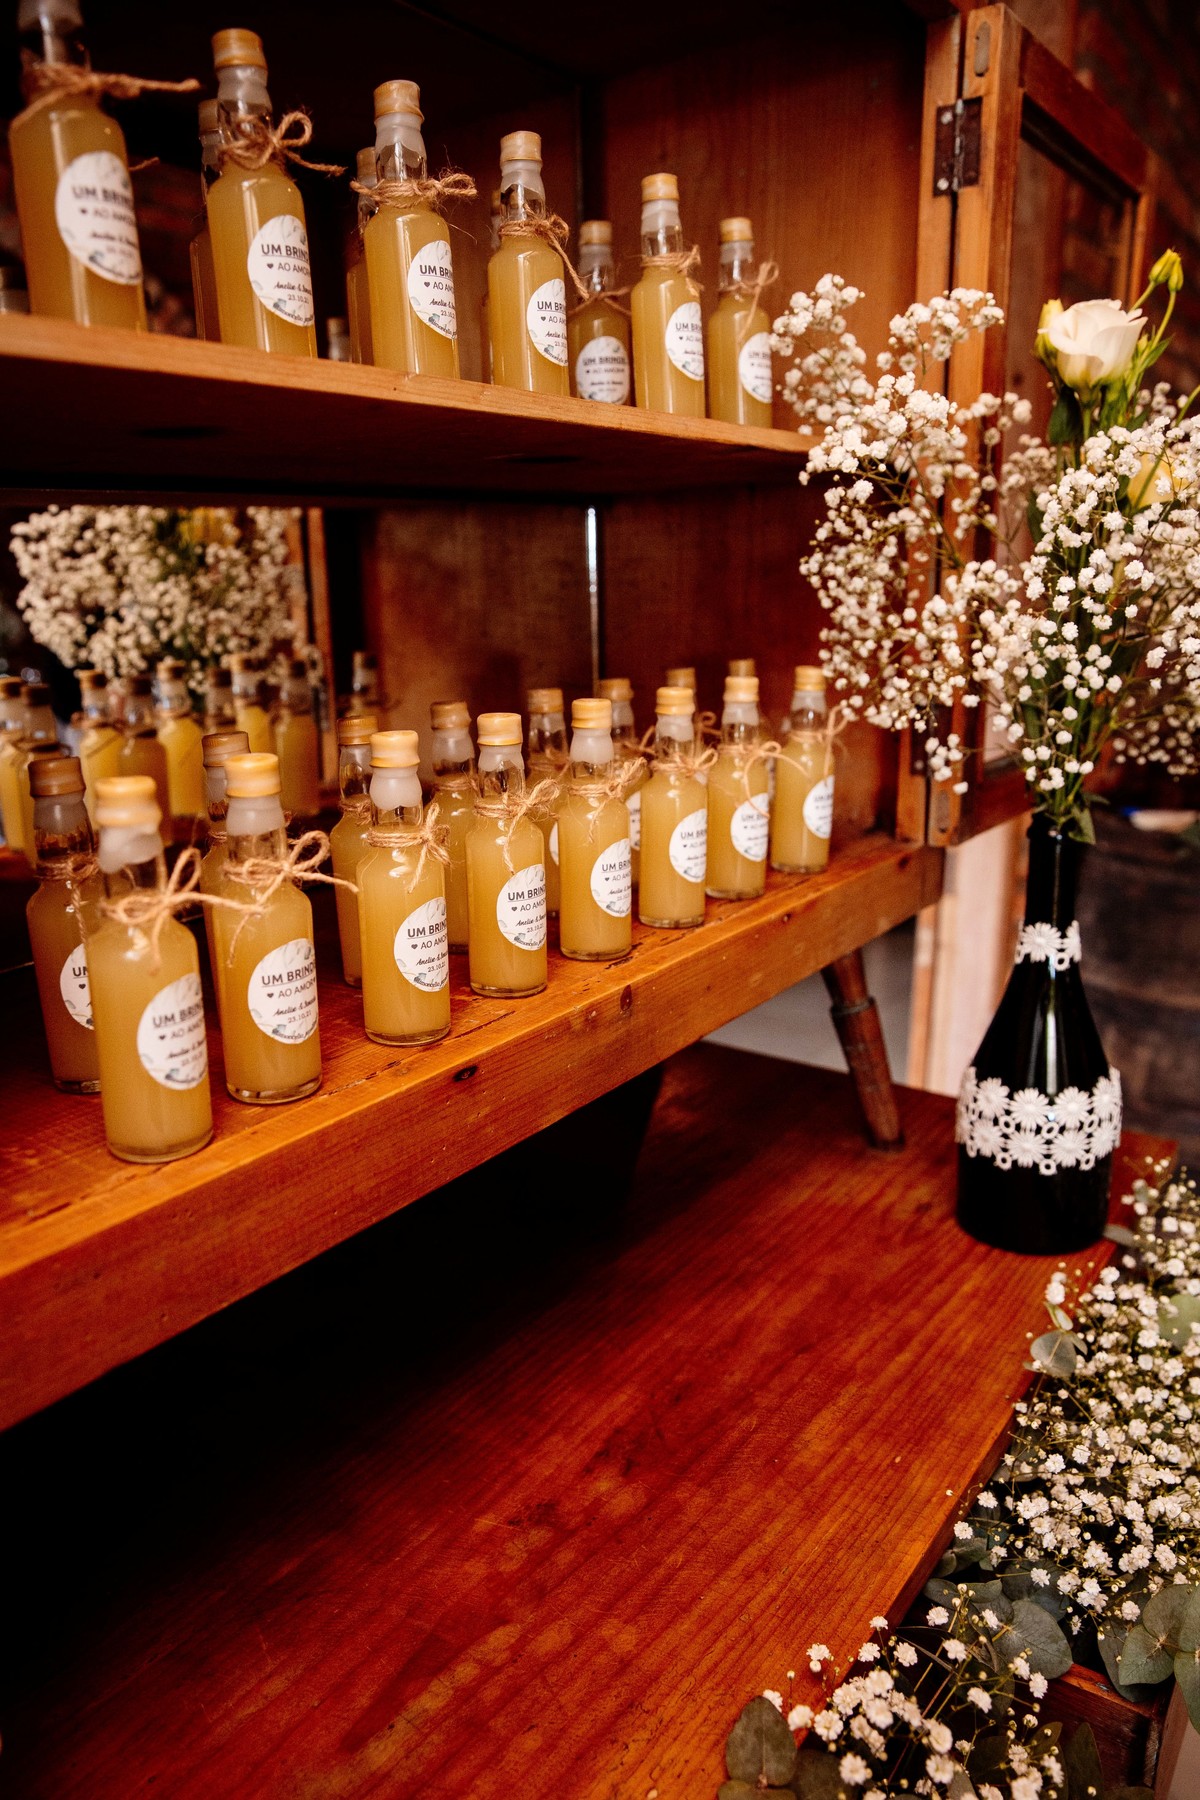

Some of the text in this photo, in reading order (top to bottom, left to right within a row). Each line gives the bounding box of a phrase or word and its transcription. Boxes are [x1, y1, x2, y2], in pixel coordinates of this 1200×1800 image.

[261, 243, 282, 256] UM
[277, 262, 291, 272] AO
[419, 264, 437, 276] UM
[432, 282, 444, 291] AO
[537, 301, 553, 311] UM
[548, 315, 558, 325] AO
[675, 322, 689, 332] UM
[601, 862, 617, 873] UM
[507, 891, 525, 902] UM
[520, 903, 532, 912] AO
[407, 926, 426, 938] UM
[420, 940, 433, 950] AO
[261, 973, 284, 986] UM
[278, 987, 293, 999] AO
[153, 1012, 176, 1028] UM
